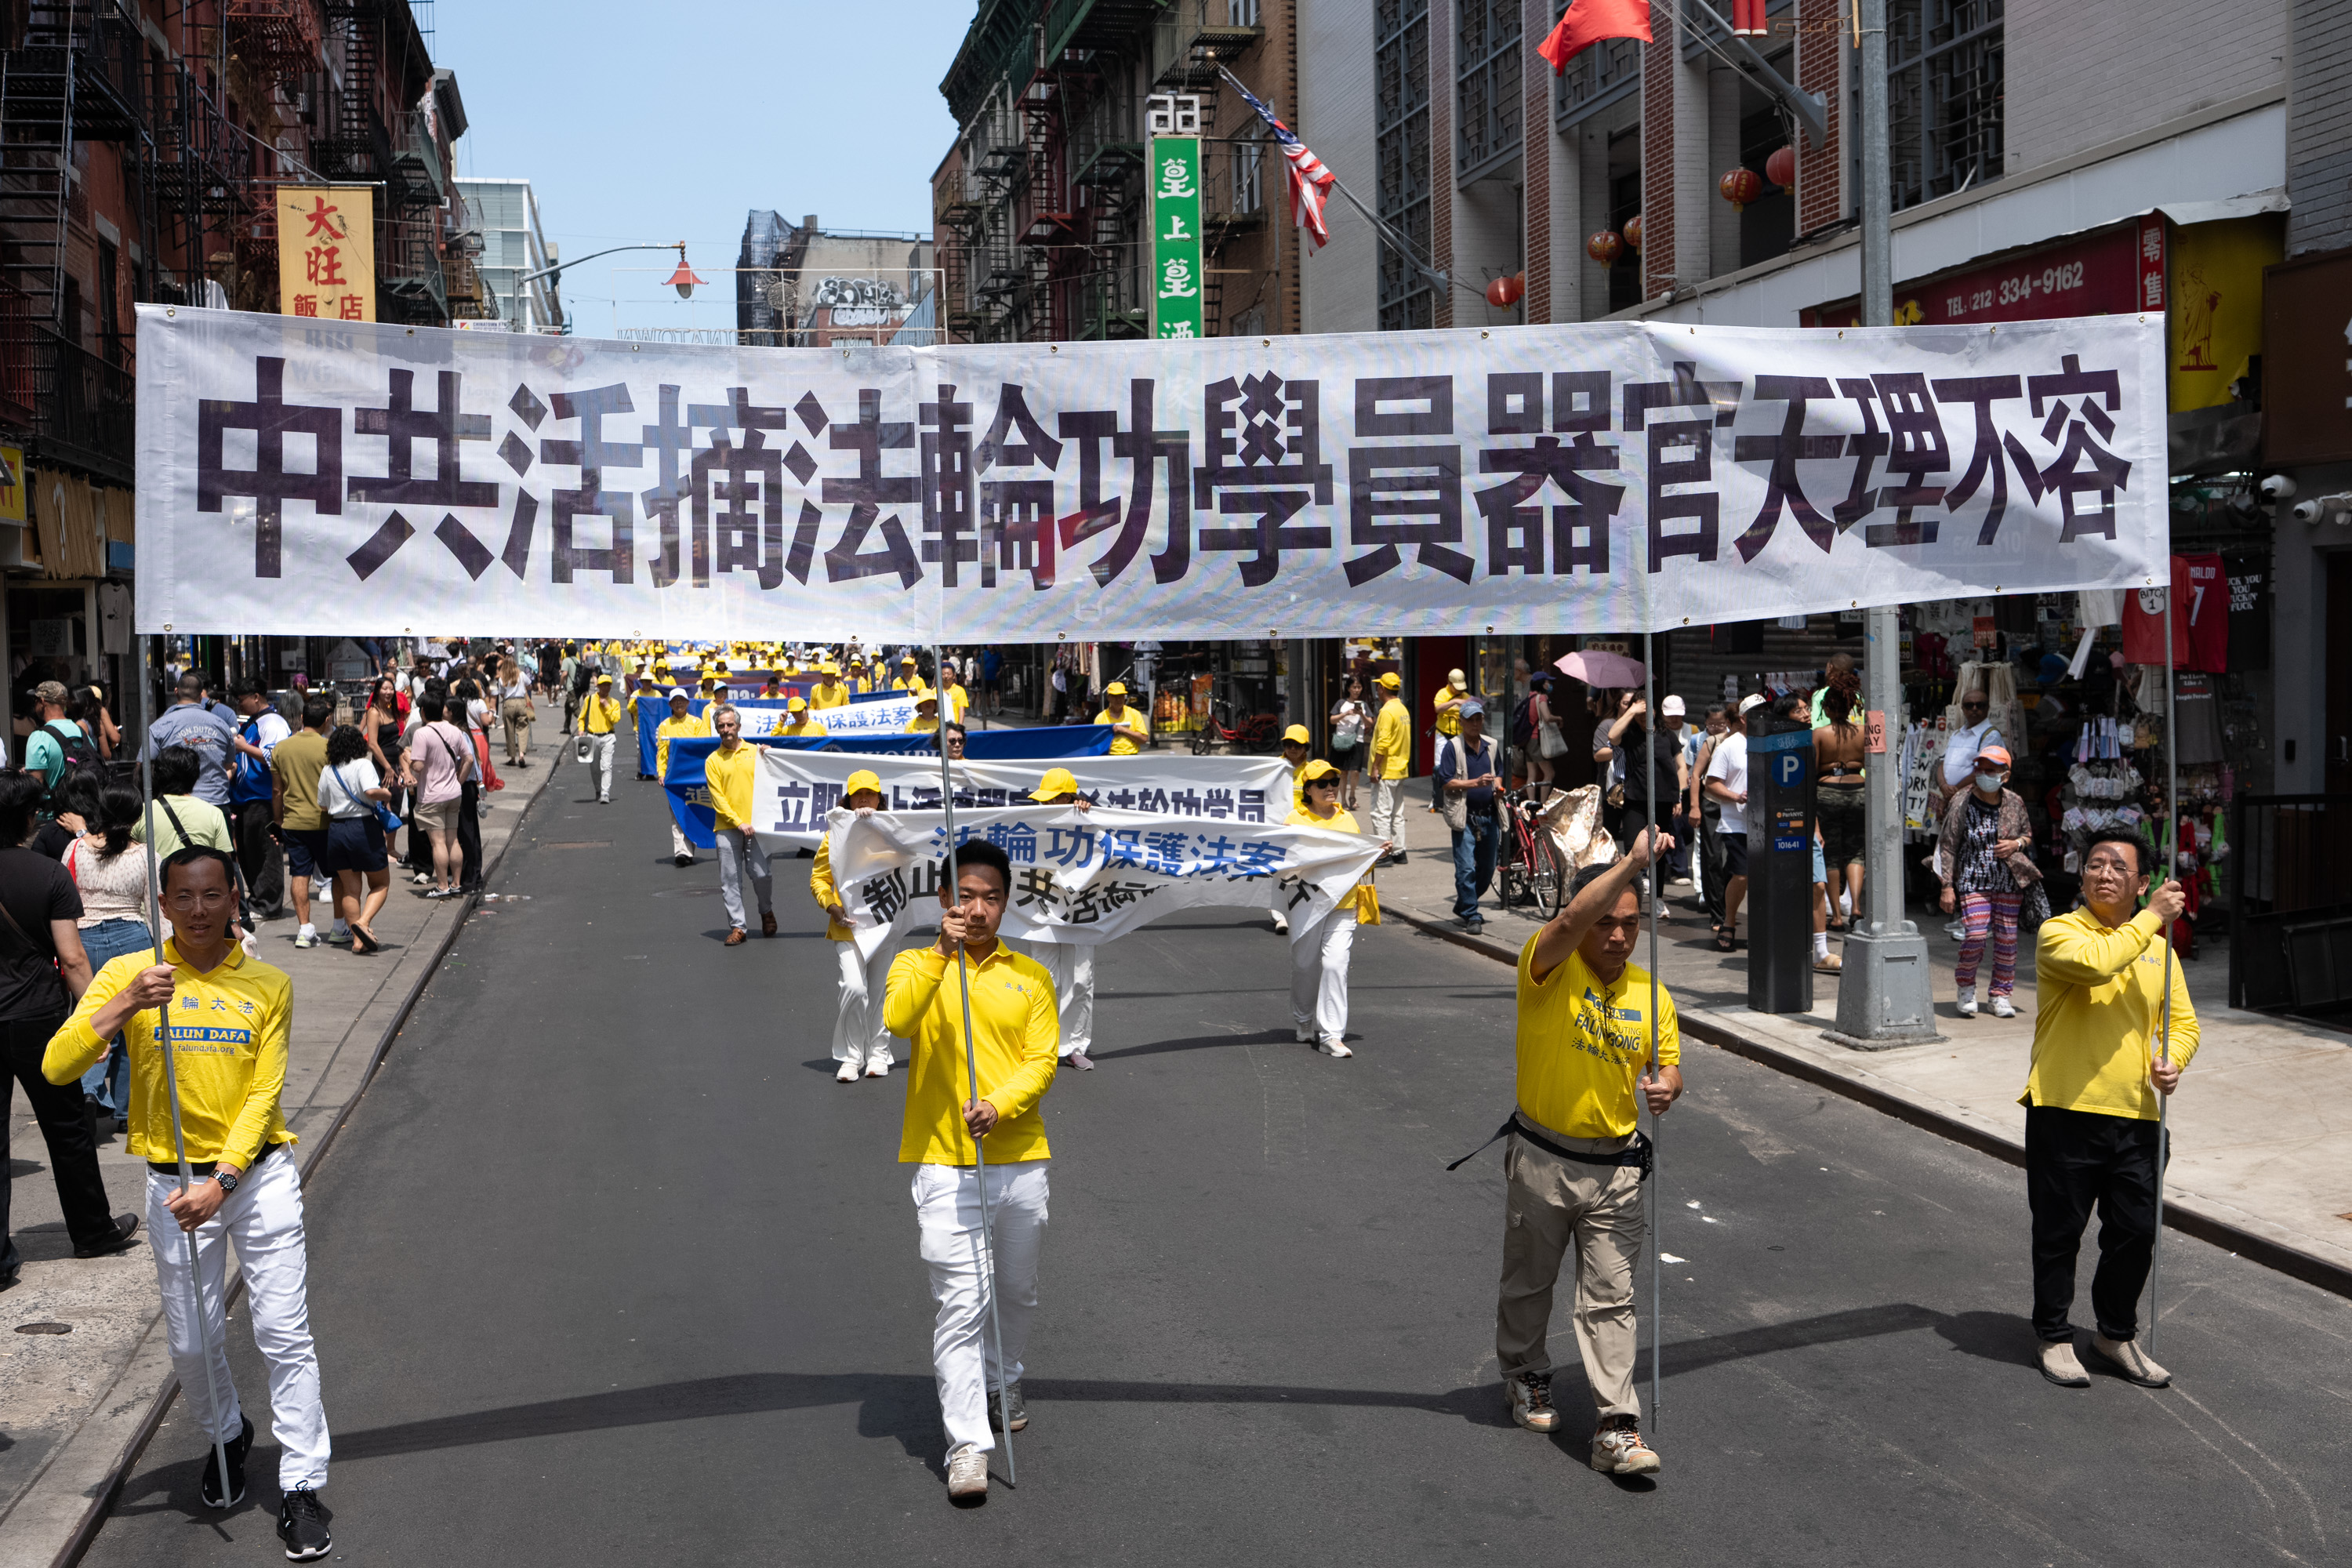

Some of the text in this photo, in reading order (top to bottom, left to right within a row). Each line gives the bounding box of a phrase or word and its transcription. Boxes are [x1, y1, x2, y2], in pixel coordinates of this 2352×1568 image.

[2143, 227, 2162, 307] 零售
[1947, 297, 1967, 318] TEL:
[1969, 289, 1997, 310] (212)
[1999, 260, 2085, 307] 334-9162
[2190, 566, 2216, 579] NALDO
[2227, 574, 2262, 586] UCK YOU
[2140, 587, 2165, 600] BITCH
[2232, 585, 2250, 593] YOU
[2149, 599, 2156, 610] 1
[2190, 586, 2205, 626] 7
[193, 725, 218, 738] DUTCH
[1783, 755, 1799, 782] P
[154, 996, 255, 1014] 輪大法
[209, 1029, 247, 1042] DAFA
[1607, 1032, 1640, 1051] GONG
